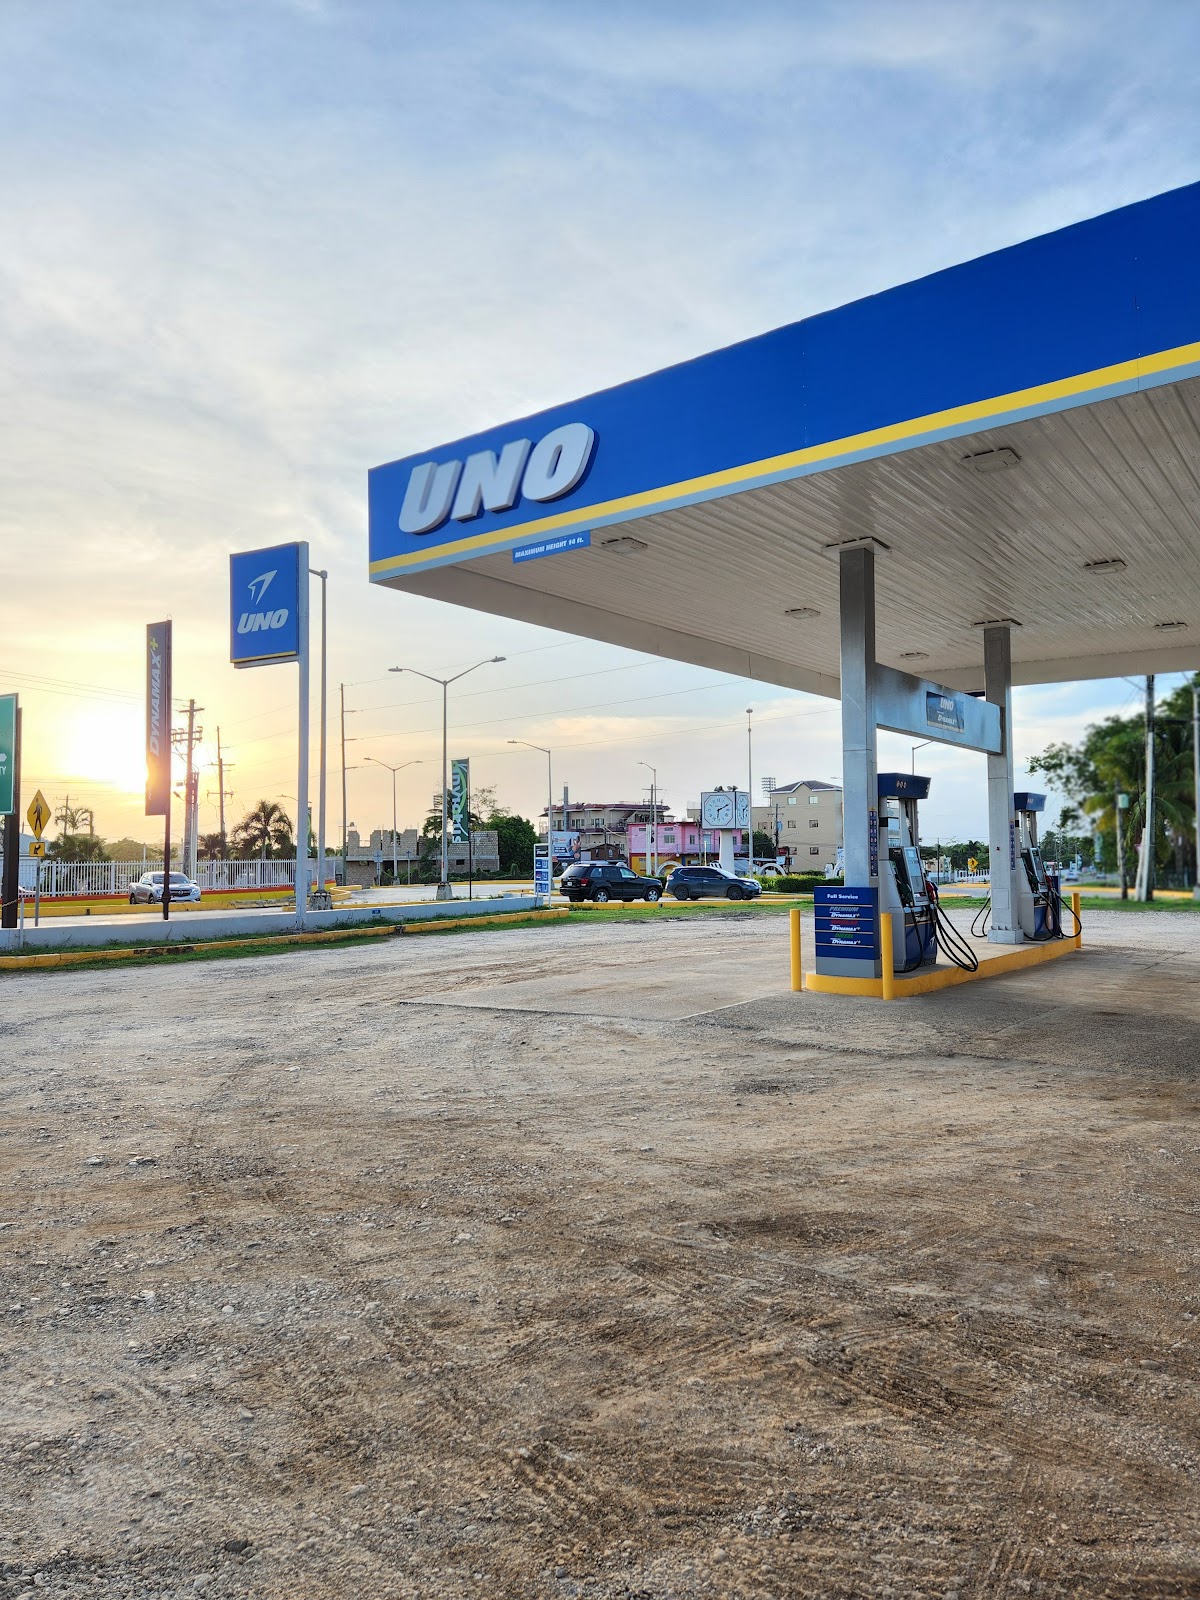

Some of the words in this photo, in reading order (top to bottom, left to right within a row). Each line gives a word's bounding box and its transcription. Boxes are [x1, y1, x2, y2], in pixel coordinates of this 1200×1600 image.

[398, 422, 595, 534] UNO
[514, 546, 545, 558] MAXIMUM
[546, 540, 567, 551] HEIGHT
[236, 608, 289, 634] UNO
[940, 697, 954, 711] UNO
